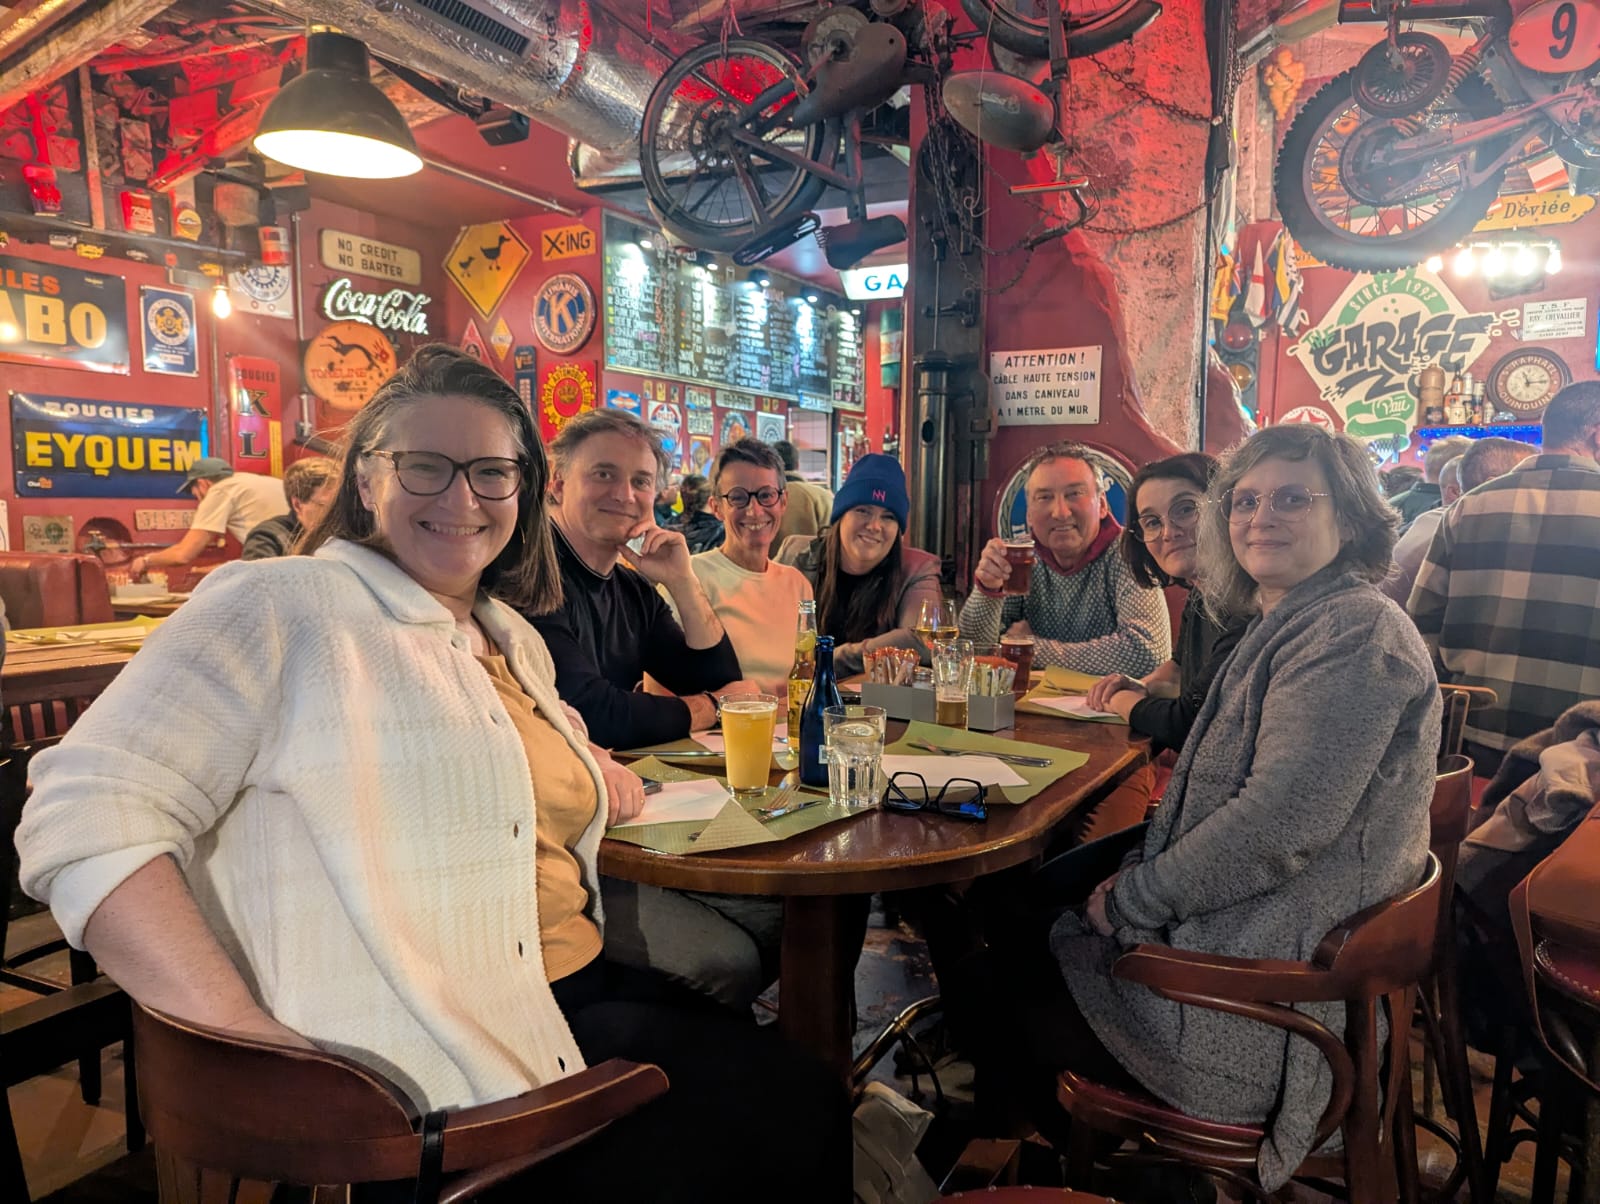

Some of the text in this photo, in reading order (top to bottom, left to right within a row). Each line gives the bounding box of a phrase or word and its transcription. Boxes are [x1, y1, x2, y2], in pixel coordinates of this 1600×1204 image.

[1549, 3, 1578, 59] 9
[1504, 200, 1571, 219] Déviée
[337, 238, 398, 261] NO CREDIT
[338, 254, 403, 277] NO BARTER
[1350, 279, 1389, 311] SINCE
[550, 293, 575, 335] K
[538, 311, 586, 345] INTERNATIONAL
[1302, 324, 1337, 350] THE
[1309, 311, 1495, 377] GARAGE
[1005, 352, 1076, 369] ATTENTION
[1023, 373, 1051, 384] HAUTE
[1056, 371, 1096, 382] TENSION
[1005, 388, 1080, 400] DANS CANIVEAU
[44, 401, 155, 421] BOUGIES
[1051, 406, 1063, 416] DU
[1068, 405, 1089, 415] MUR
[25, 431, 202, 477] EYQUEM
